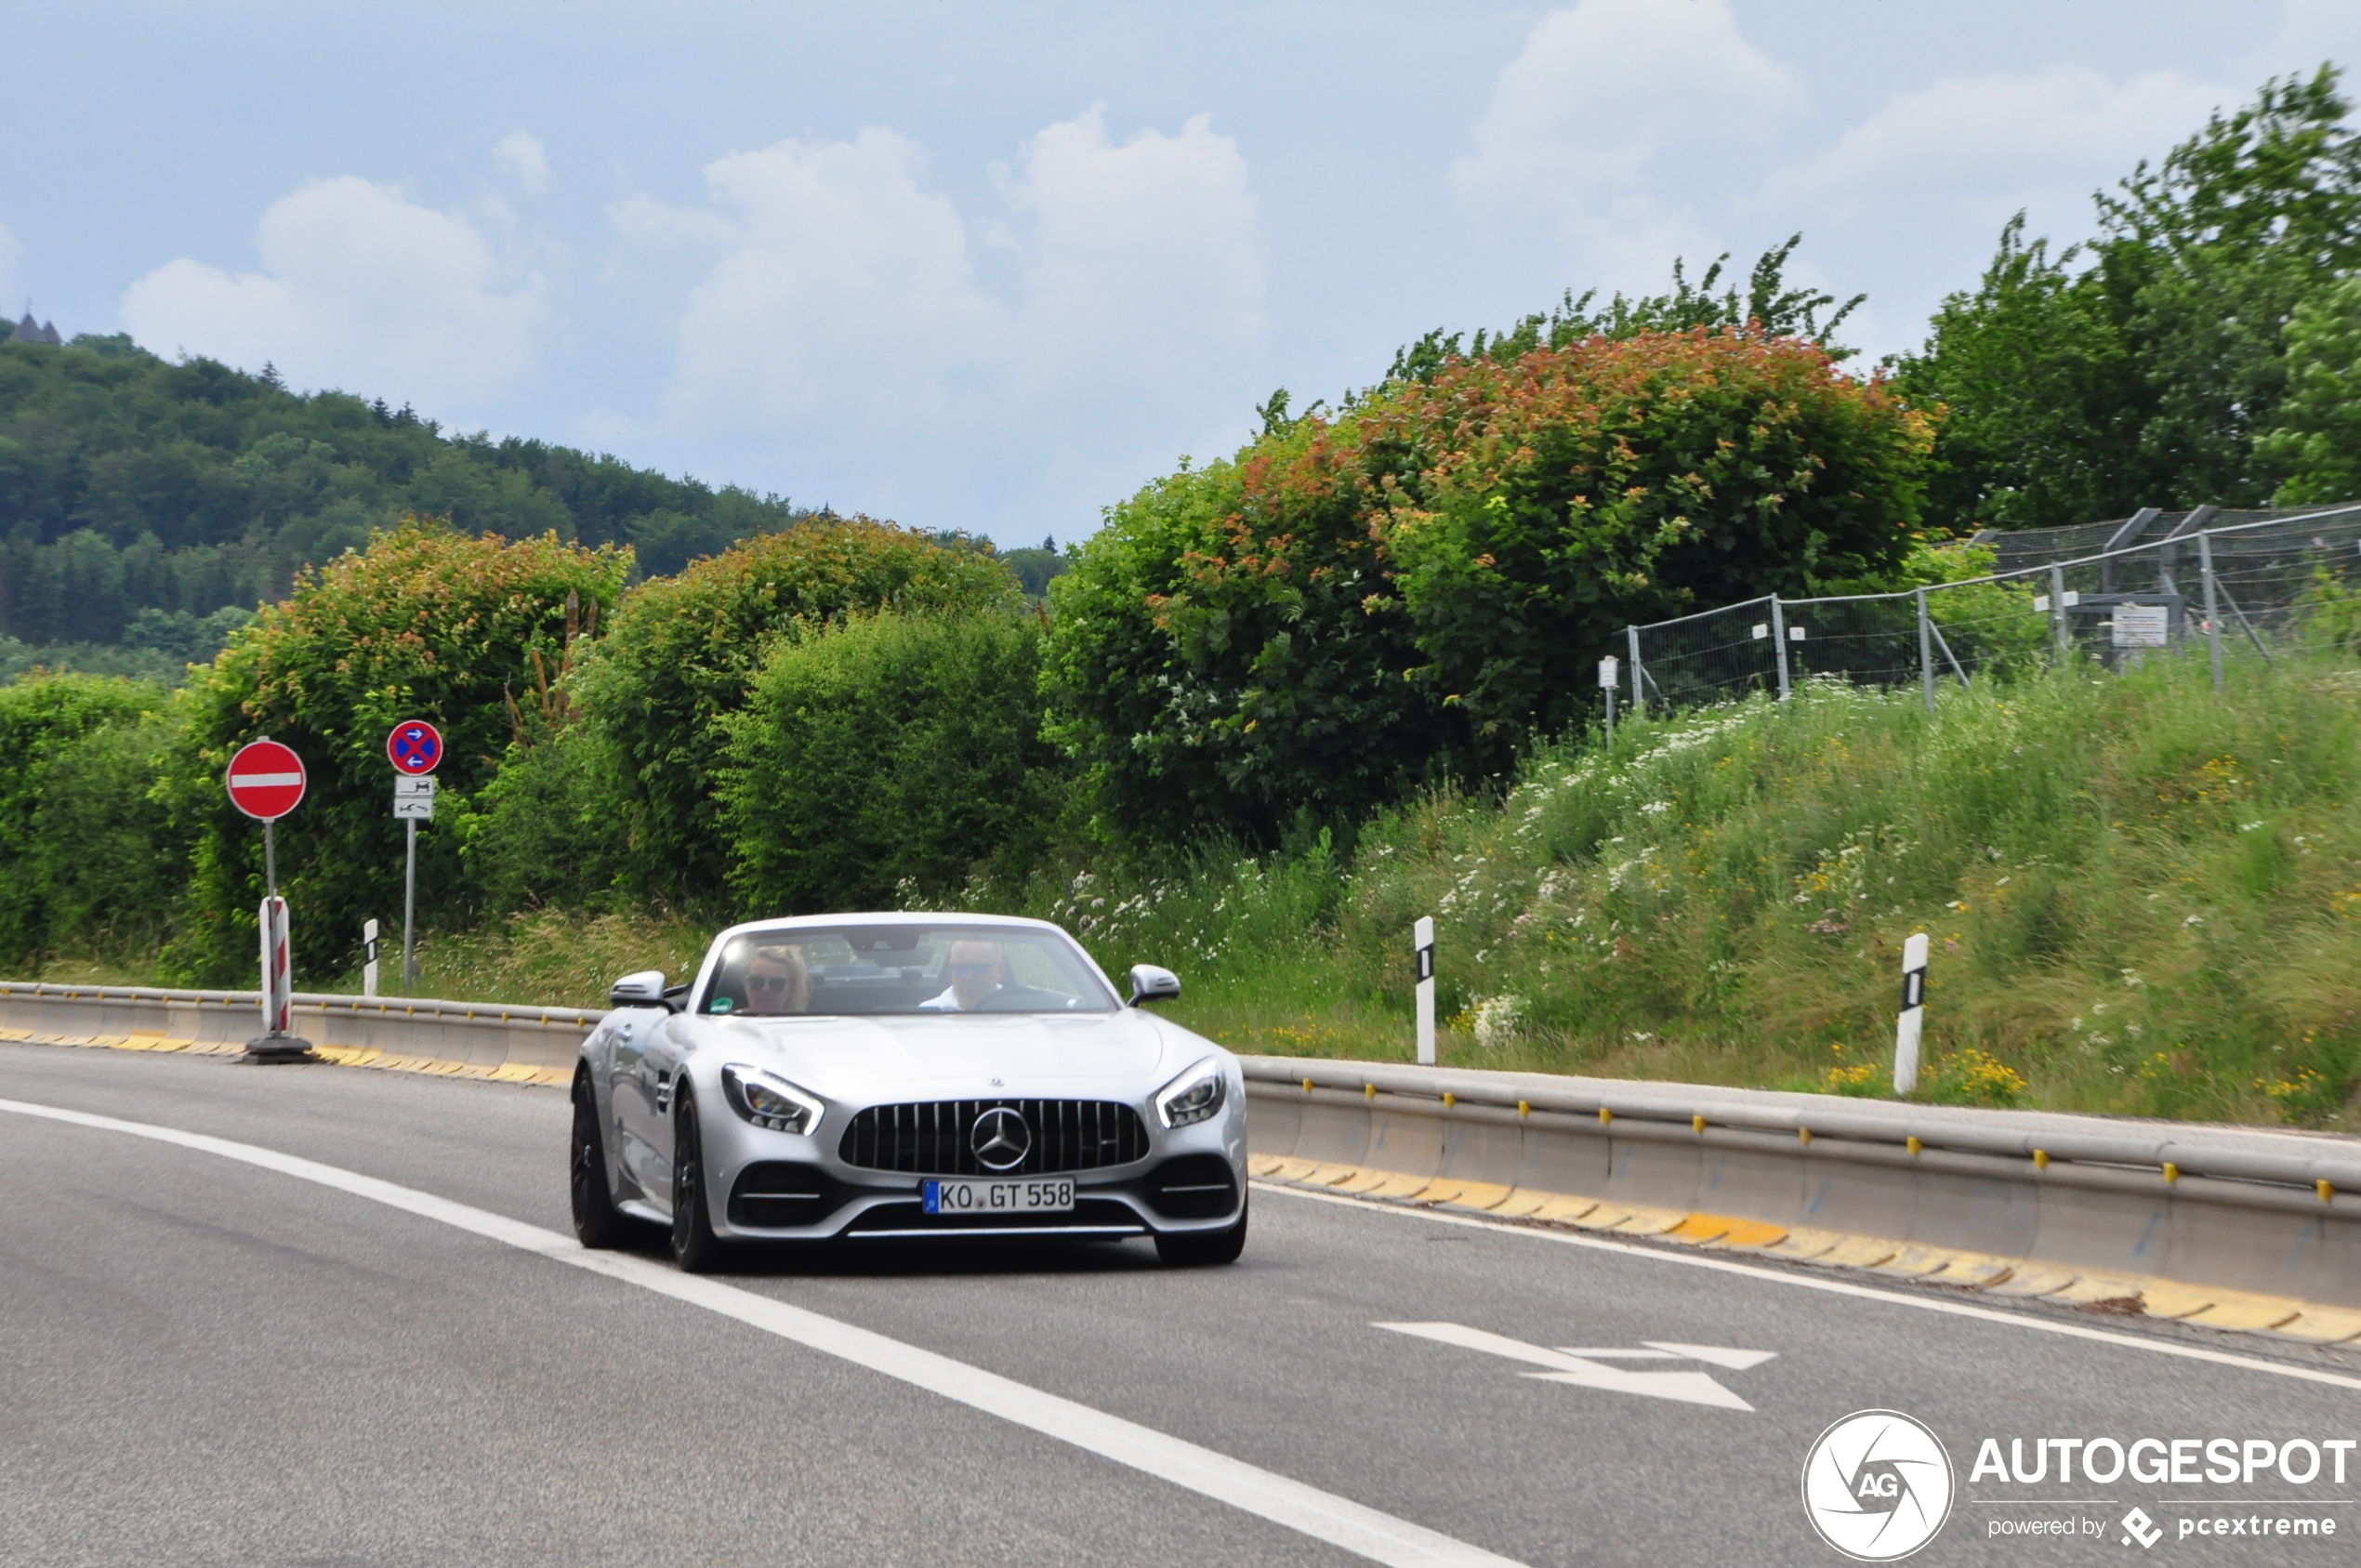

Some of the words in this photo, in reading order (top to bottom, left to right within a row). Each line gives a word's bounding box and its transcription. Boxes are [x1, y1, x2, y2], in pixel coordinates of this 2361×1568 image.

[941, 1184, 972, 1208] KO
[990, 1184, 1021, 1207] GT
[1027, 1183, 1071, 1206] 558
